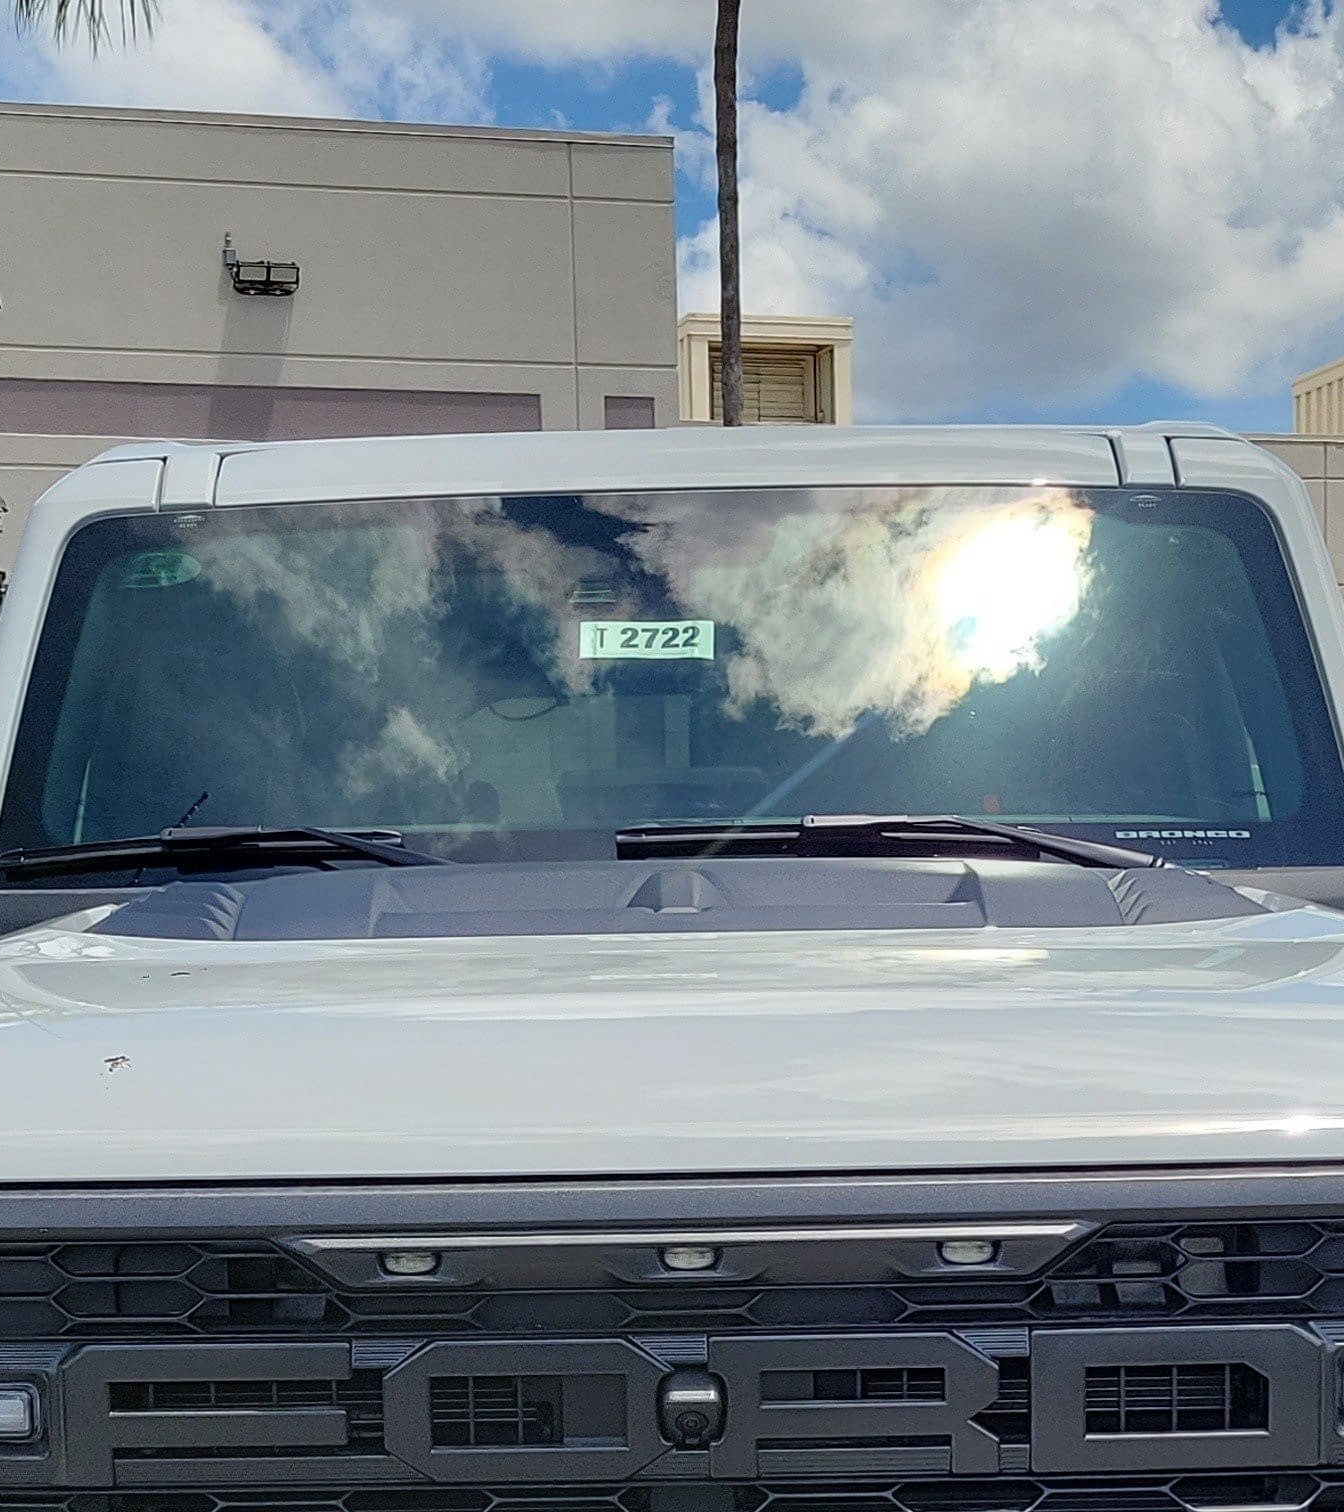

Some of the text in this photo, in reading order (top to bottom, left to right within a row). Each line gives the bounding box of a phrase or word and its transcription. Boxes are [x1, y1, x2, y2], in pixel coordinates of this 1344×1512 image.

[620, 626, 701, 649] 2722
[1115, 830, 1251, 839] BRONCO
[61, 1325, 1322, 1487] FORD
